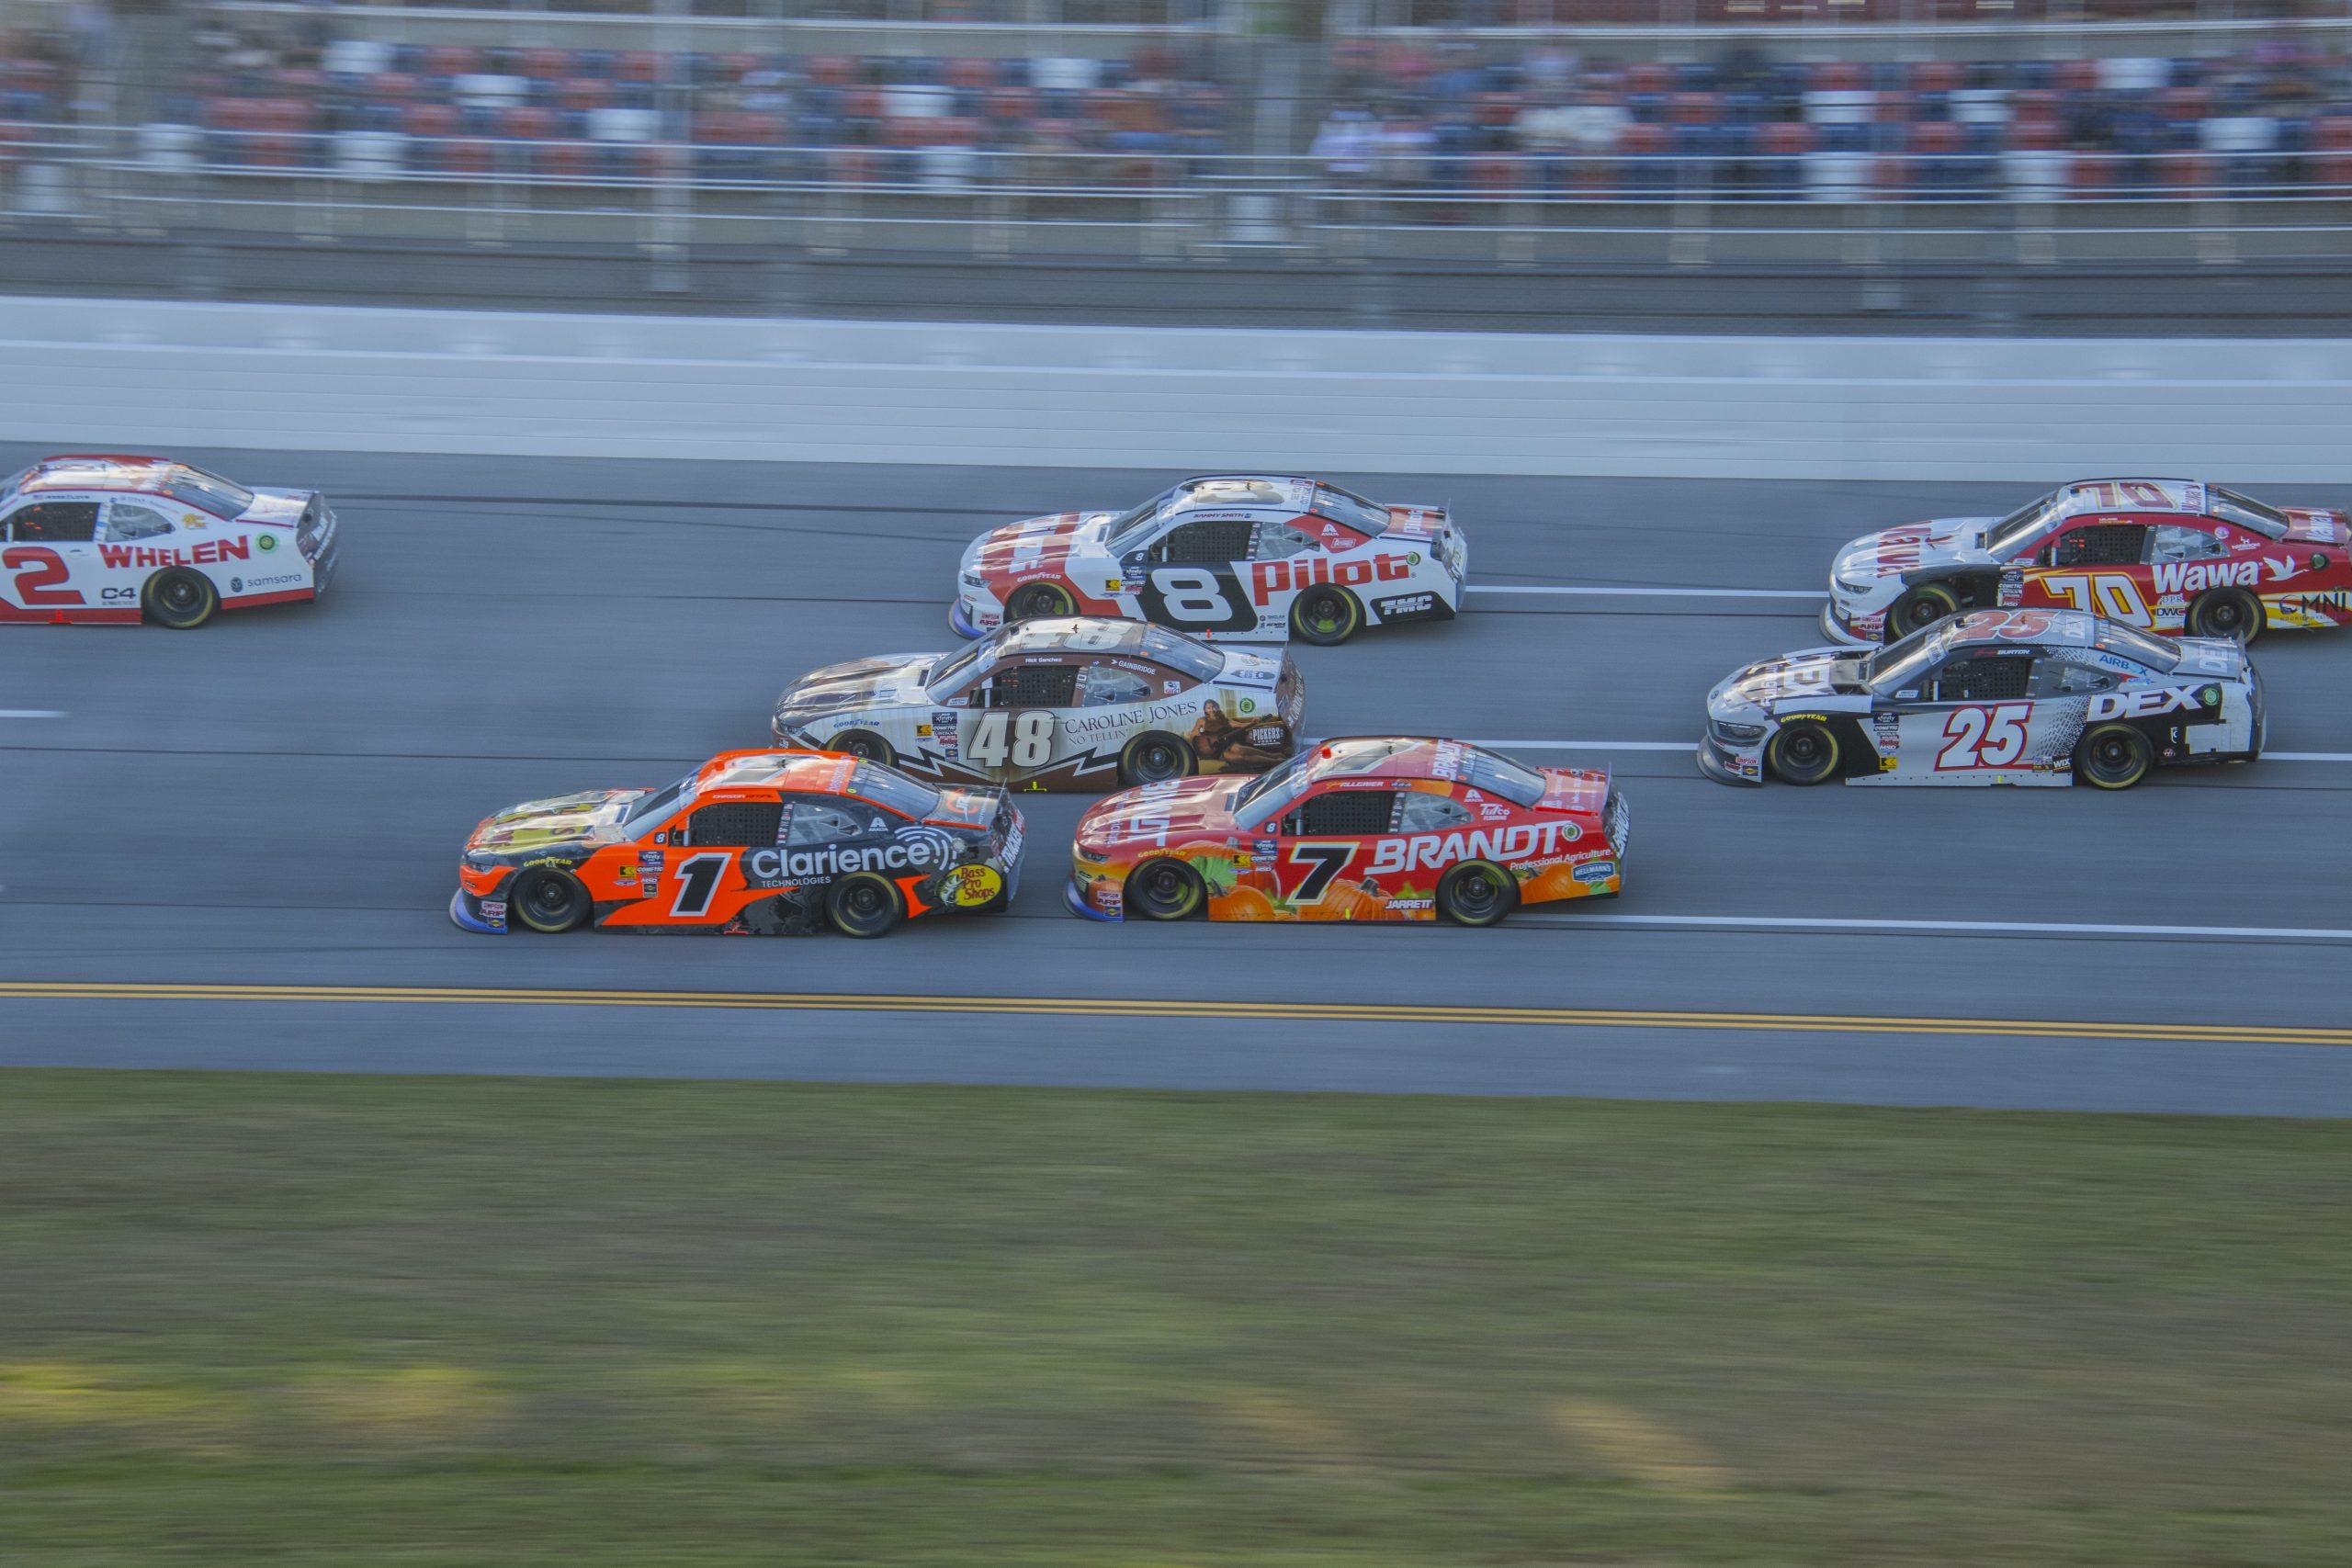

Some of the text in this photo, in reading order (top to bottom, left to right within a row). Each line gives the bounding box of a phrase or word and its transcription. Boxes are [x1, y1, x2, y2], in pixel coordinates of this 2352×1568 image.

[97, 535, 251, 569] WHELEN
[1134, 552, 1145, 561] 8
[2, 546, 87, 605] 2
[247, 572, 302, 588] samsara
[1016, 571, 1062, 583] GOODYEAR
[1251, 553, 1409, 607] pilot
[2153, 560, 2259, 594] Wawa
[101, 587, 136, 600] C4
[1148, 568, 1234, 622] 8
[2039, 571, 2154, 630] 70
[1380, 595, 1433, 616] TMC
[2156, 607, 2186, 616] DWC
[1949, 610, 2061, 644] 25
[1118, 660, 1157, 675] GAINBRIDGE
[2086, 684, 2205, 722] DEX
[833, 718, 880, 728] GOODYEAR
[1065, 701, 1197, 734] CAROLINE JONES
[1780, 714, 1827, 723] GOODYEAR
[967, 709, 1057, 768] 48
[1252, 727, 1281, 739] PICKERS
[1934, 702, 2034, 772] 25
[1069, 737, 1086, 745] NO
[2053, 760, 2071, 769] WIX
[1266, 822, 1276, 833] 8
[656, 832, 665, 843] 8
[1137, 847, 1186, 858] GOODYEAR
[1363, 820, 1574, 875] BRANDT
[523, 856, 573, 867] GOODYEAR
[752, 843, 931, 878] Clarience
[1510, 848, 1611, 871] Professional Agriculture
[961, 867, 986, 879] Bass
[1285, 841, 1361, 906] 7
[669, 852, 733, 917] 1
[761, 875, 831, 888] TECHNOLOGIES
[963, 878, 982, 889] Pro
[964, 887, 995, 900] Shops
[1385, 898, 1434, 909] JARRETT
